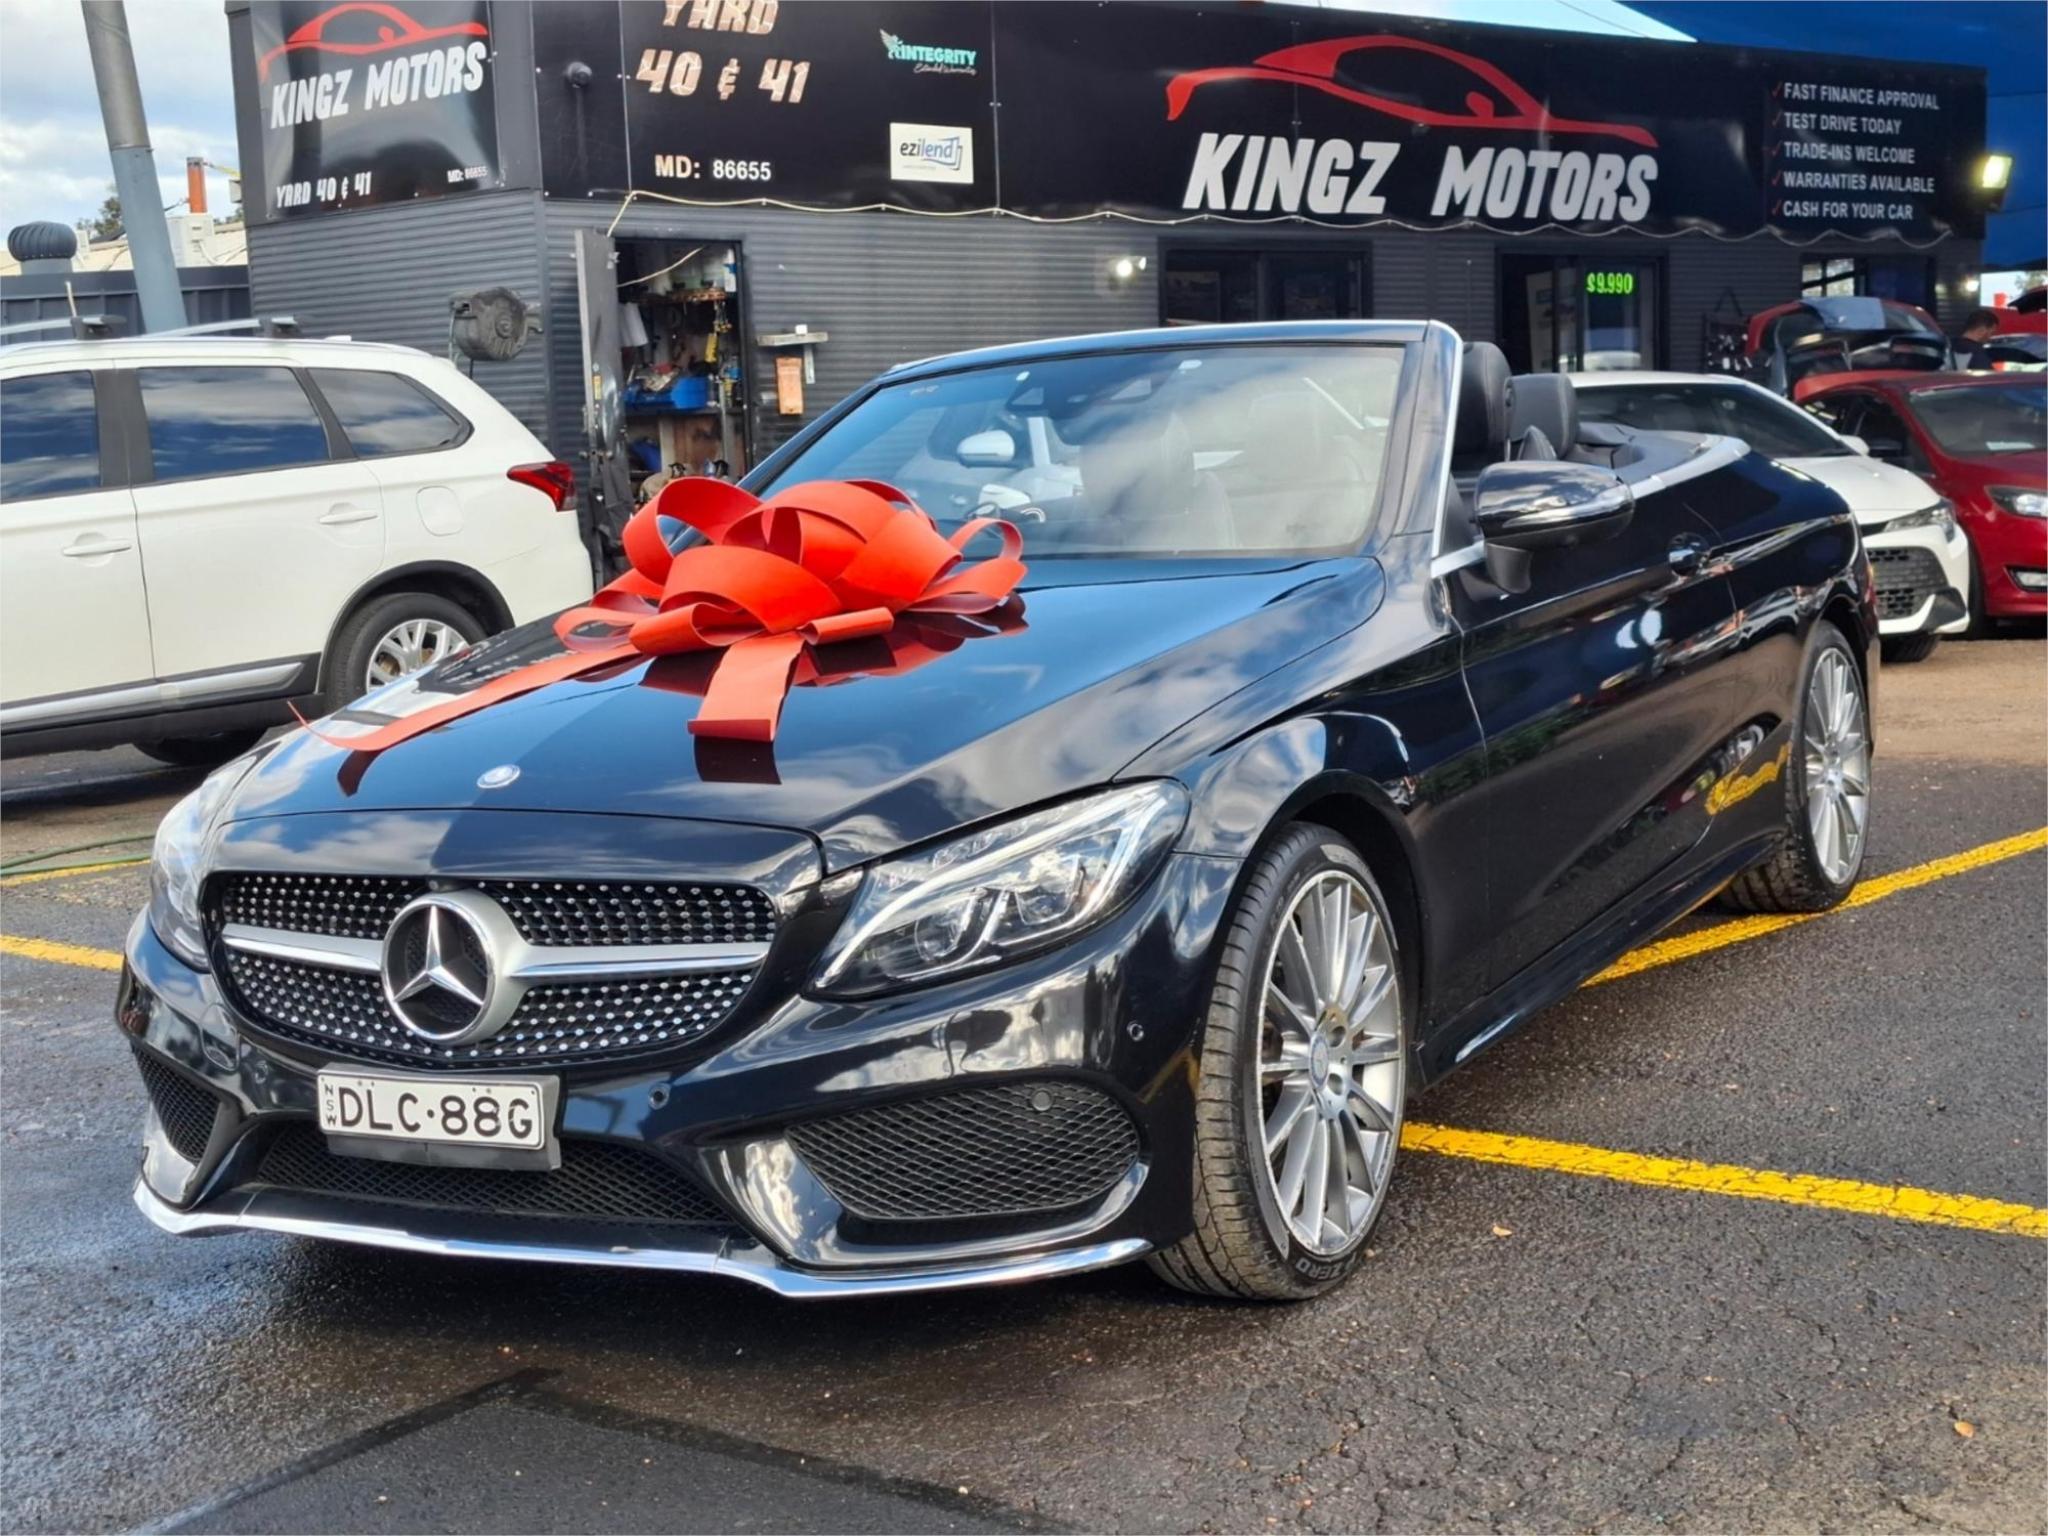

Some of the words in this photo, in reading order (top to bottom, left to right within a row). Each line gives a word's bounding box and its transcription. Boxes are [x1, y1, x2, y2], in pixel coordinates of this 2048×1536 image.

[662, 0, 779, 34] YARD
[902, 44, 976, 66] INTEGRITY
[270, 69, 354, 129] KINGZ
[364, 41, 487, 111] MOTORS
[635, 48, 702, 96] 40
[758, 58, 811, 103] 41
[1783, 82, 1817, 100] FAST
[1820, 85, 1875, 104] FINANCE
[1877, 90, 1940, 110] APPROVAL
[1784, 112, 1816, 130] TEST
[1820, 115, 1858, 133] DRIVE
[1861, 117, 1902, 135] TODAY
[900, 137, 954, 159] ezilend
[1784, 141, 1852, 161] TRADE-INS
[1855, 145, 1916, 164] WELCOME
[447, 168, 464, 183] MD:
[655, 154, 701, 179] MD:
[713, 160, 772, 182] 86655
[1182, 132, 1401, 215] KINGZ
[1430, 144, 1659, 222] MOTORS
[276, 180, 311, 208] YARD
[316, 176, 336, 202] 40
[354, 172, 372, 196] 41
[1783, 171, 1867, 190] WARRANTIES
[1869, 174, 1935, 193] AVAILABLE
[1783, 201, 1819, 217] CASH
[1823, 201, 1849, 218] FOR
[1852, 202, 1887, 219] YOUR
[1888, 204, 1913, 220] CAR
[1586, 272, 1633, 295] $9.990
